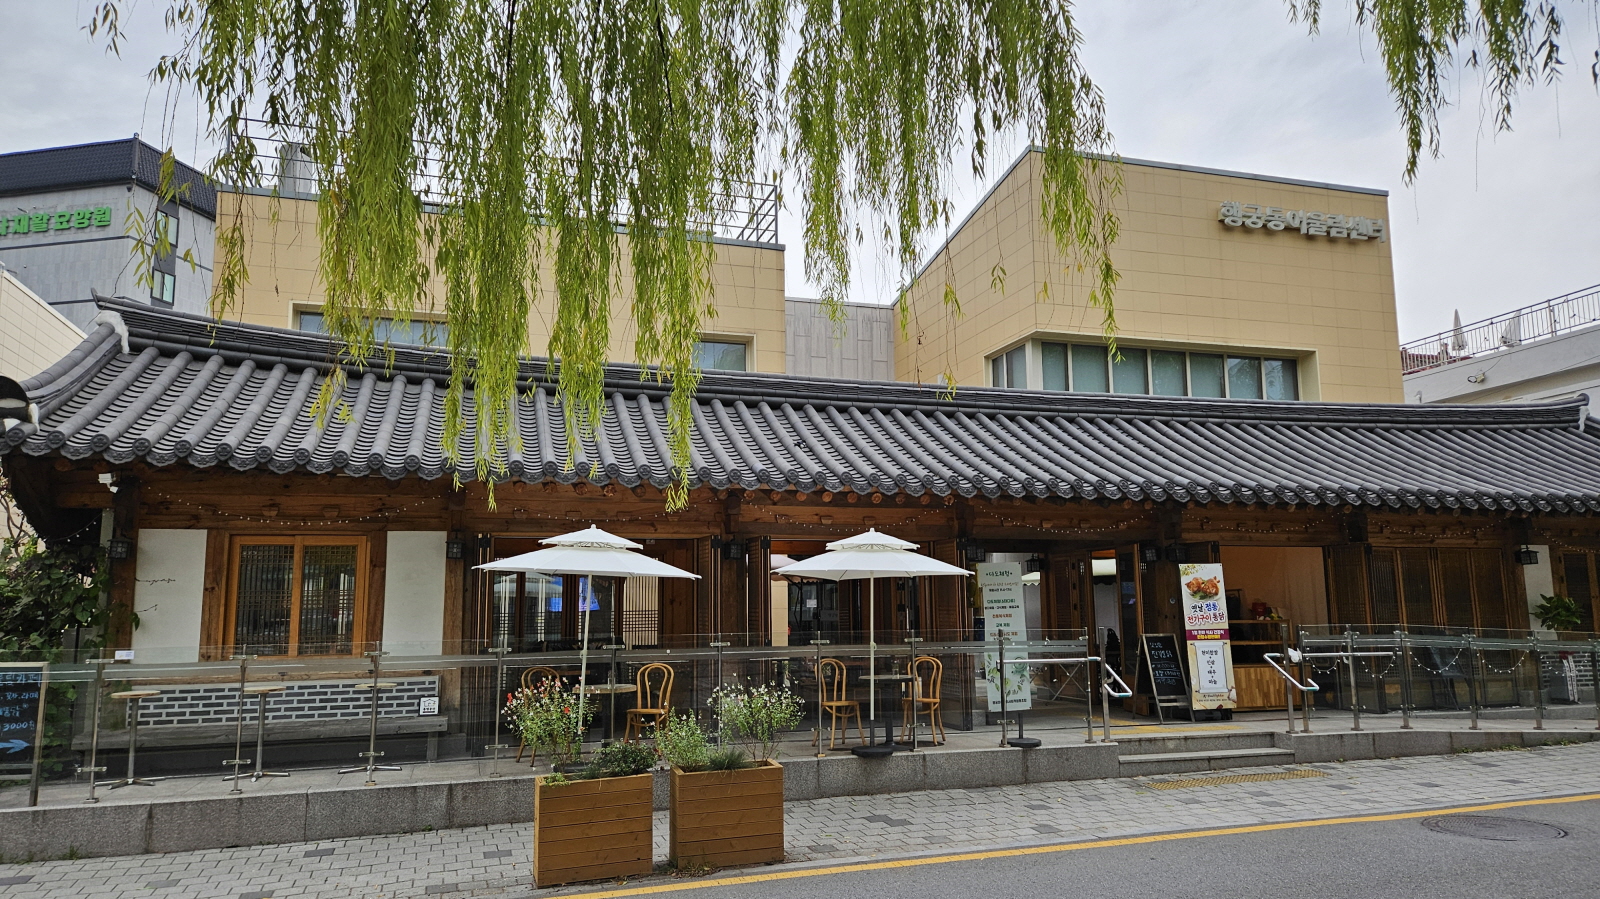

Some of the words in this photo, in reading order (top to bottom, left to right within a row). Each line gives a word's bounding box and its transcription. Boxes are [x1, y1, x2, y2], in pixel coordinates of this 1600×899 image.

[1218, 200, 1386, 243] 행궁동어울림센터
[1190, 602, 1204, 613] 옛날
[1204, 601, 1219, 612] 정통
[1187, 612, 1212, 624] 전기구이
[1212, 611, 1225, 621] 통닭
